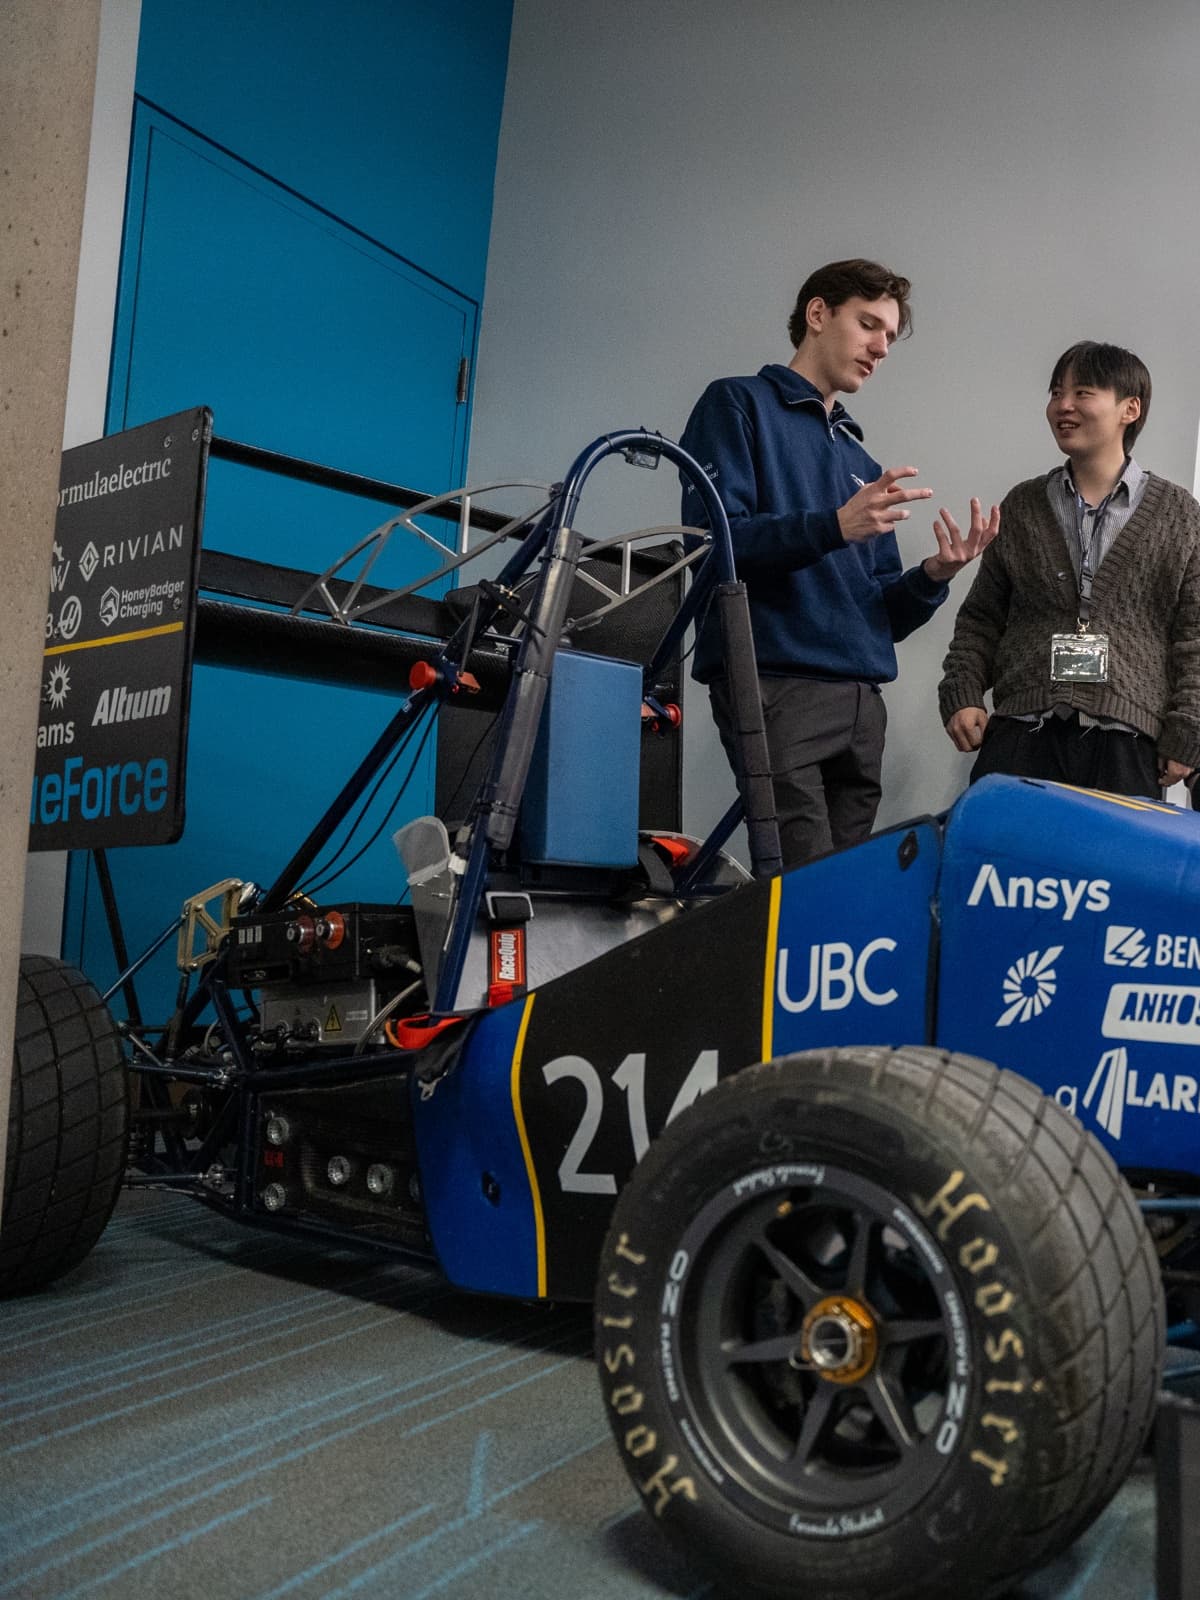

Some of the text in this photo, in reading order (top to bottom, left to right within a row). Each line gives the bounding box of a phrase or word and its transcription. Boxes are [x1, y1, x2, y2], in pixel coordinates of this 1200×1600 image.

[56, 457, 171, 507] rmulaelectric
[103, 524, 183, 568] RIVIAN
[120, 599, 163, 619] Charging
[121, 580, 184, 605] HoneyBadger
[91, 685, 172, 726] Altium
[967, 864, 1110, 921] Ansys
[777, 937, 898, 1013] UBC
